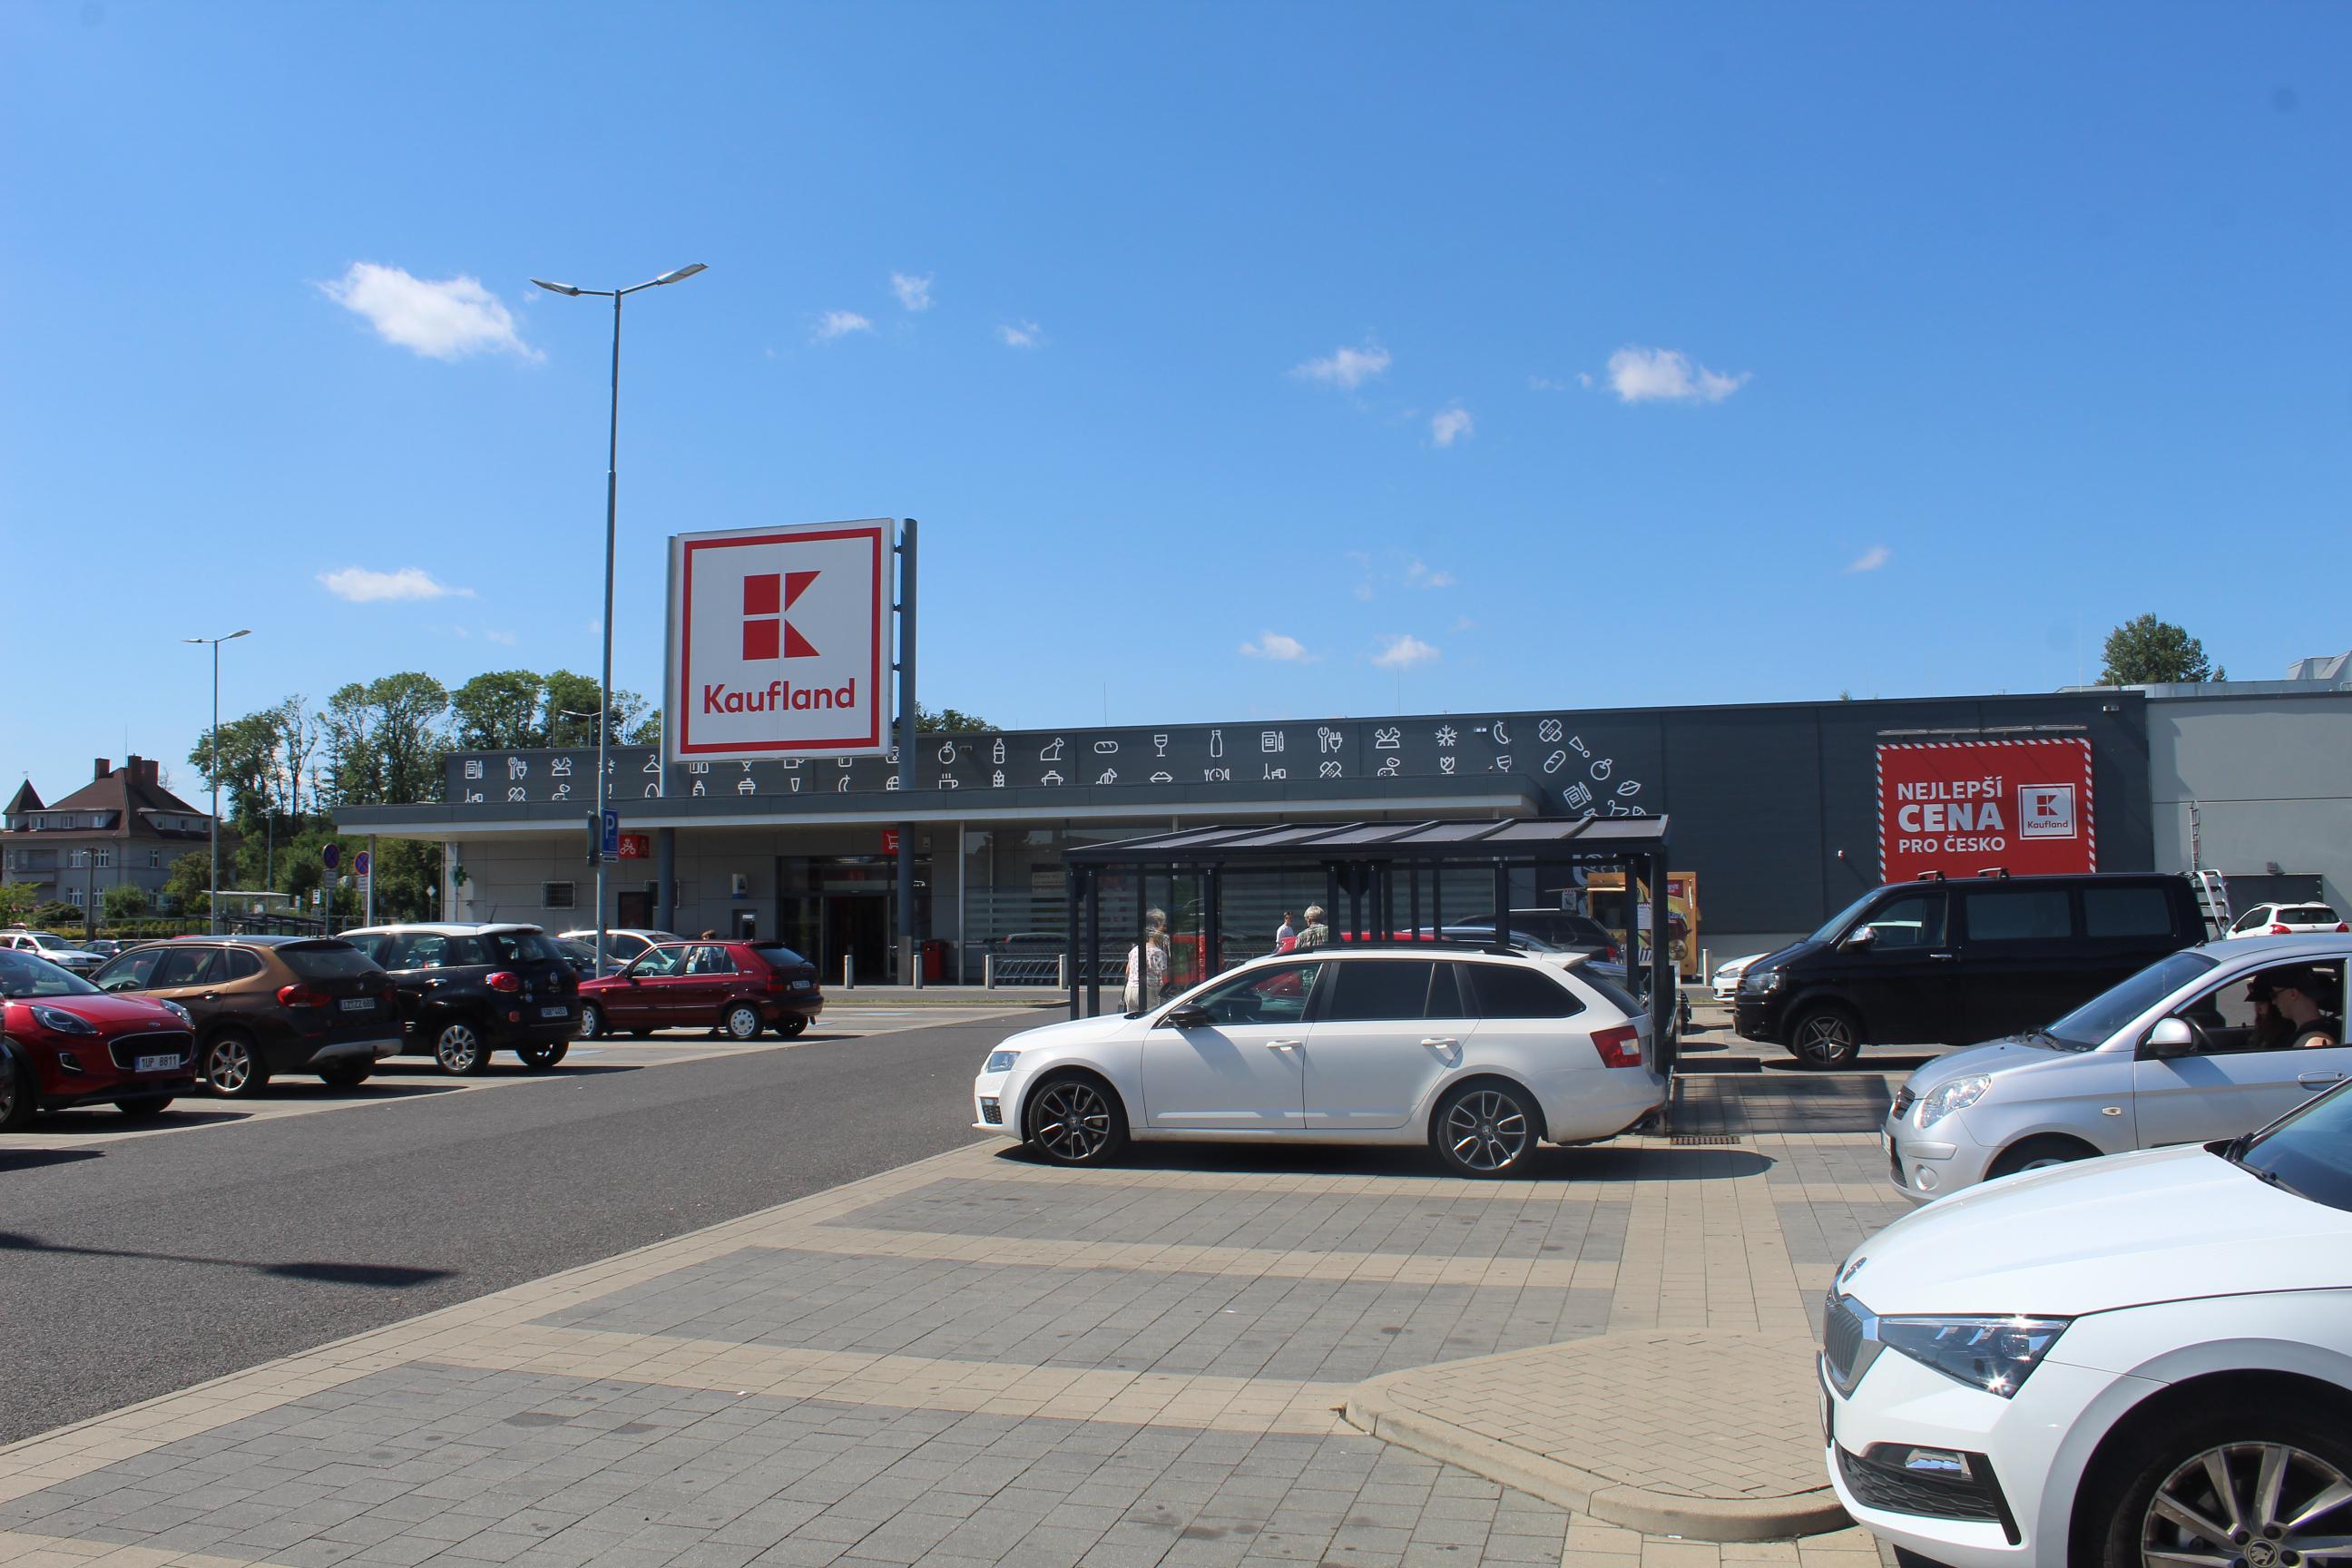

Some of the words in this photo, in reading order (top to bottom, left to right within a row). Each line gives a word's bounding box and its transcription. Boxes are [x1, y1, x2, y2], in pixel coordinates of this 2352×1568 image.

[704, 678, 855, 714] Kaufland
[1897, 776, 2003, 800] NEJLEPŠÍ
[605, 815, 615, 839] P
[1897, 802, 2004, 833] CENA
[2027, 820, 2069, 829] Kaufland
[1898, 838, 1938, 854] PRO
[1944, 835, 2005, 853] ČESKO
